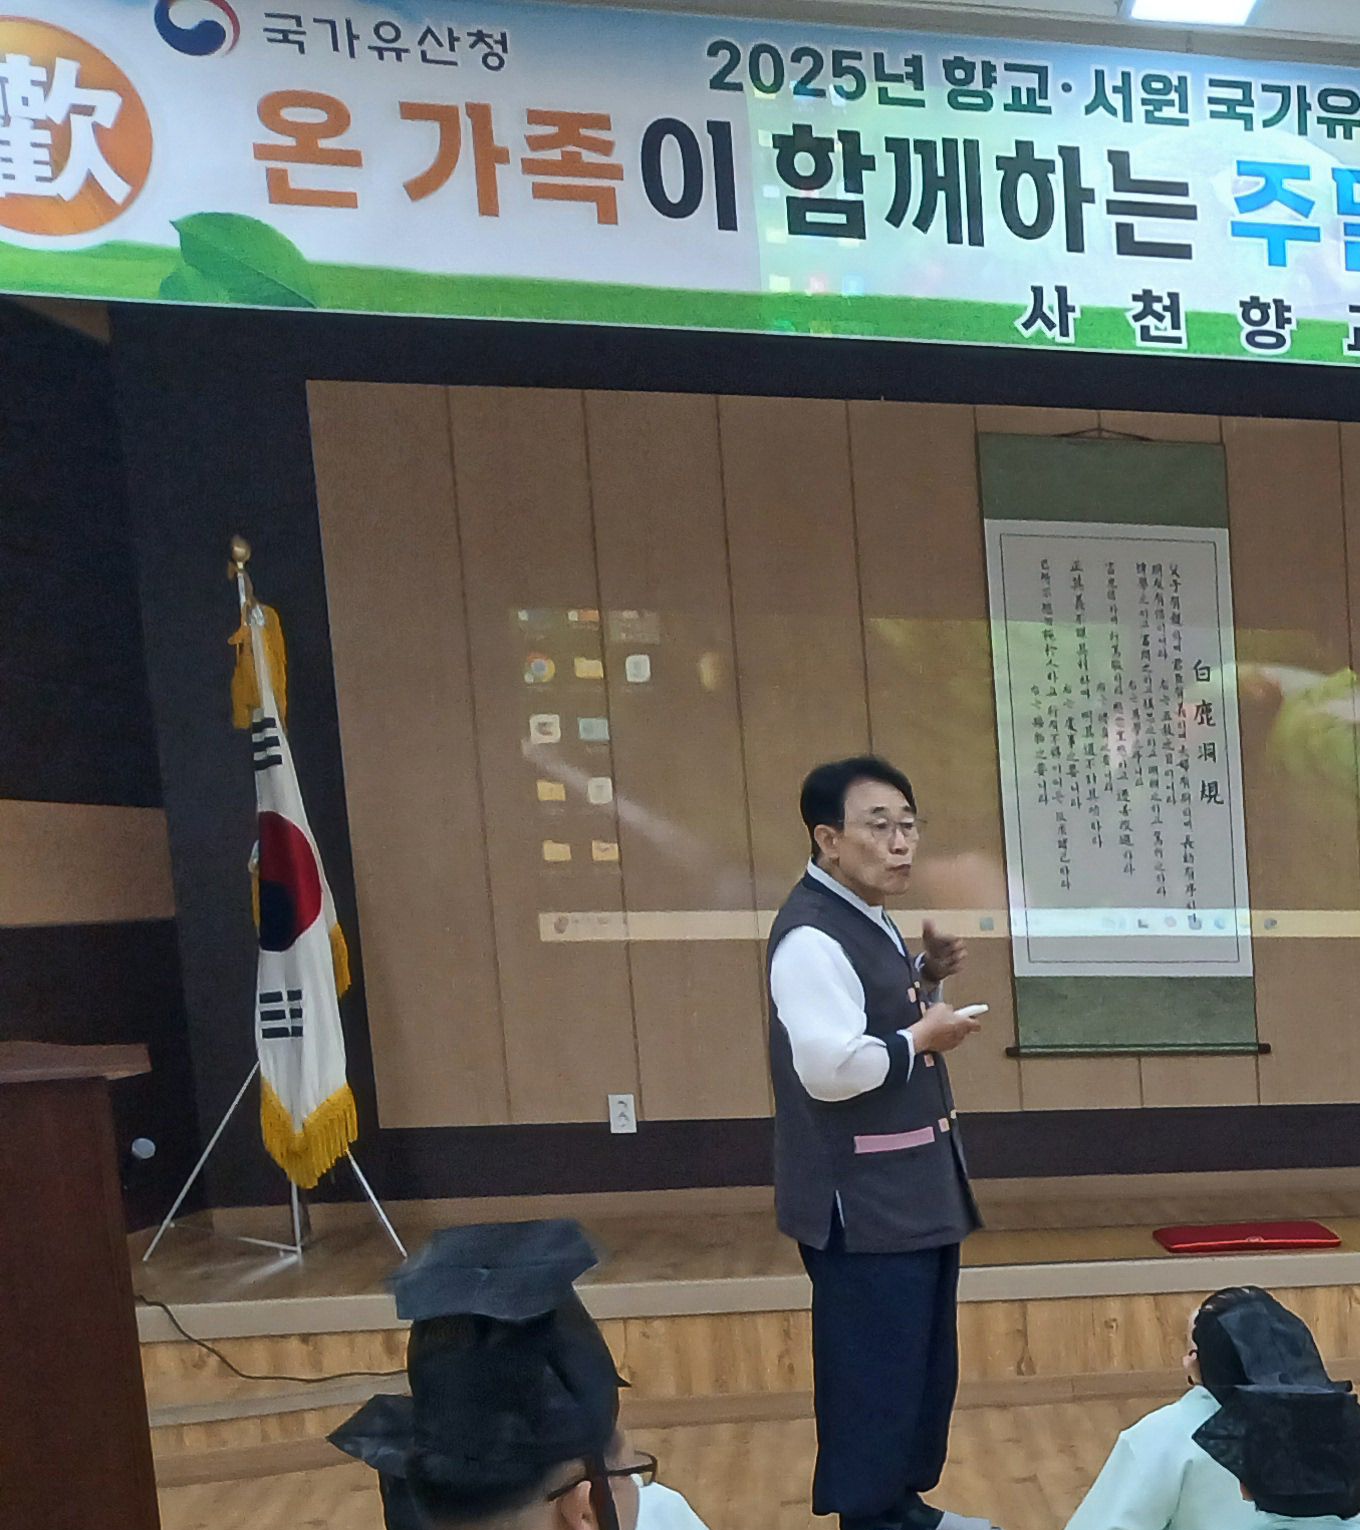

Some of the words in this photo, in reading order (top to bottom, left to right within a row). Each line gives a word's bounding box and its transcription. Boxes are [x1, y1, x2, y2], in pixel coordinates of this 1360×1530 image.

[263, 12, 509, 72] 국가유산청
[706, 39, 926, 108] 2025년
[942, 55, 1190, 126] 향교·서원
[252, 89, 363, 209] 온
[399, 101, 739, 232] 가족이
[771, 123, 1198, 261] 함께하는
